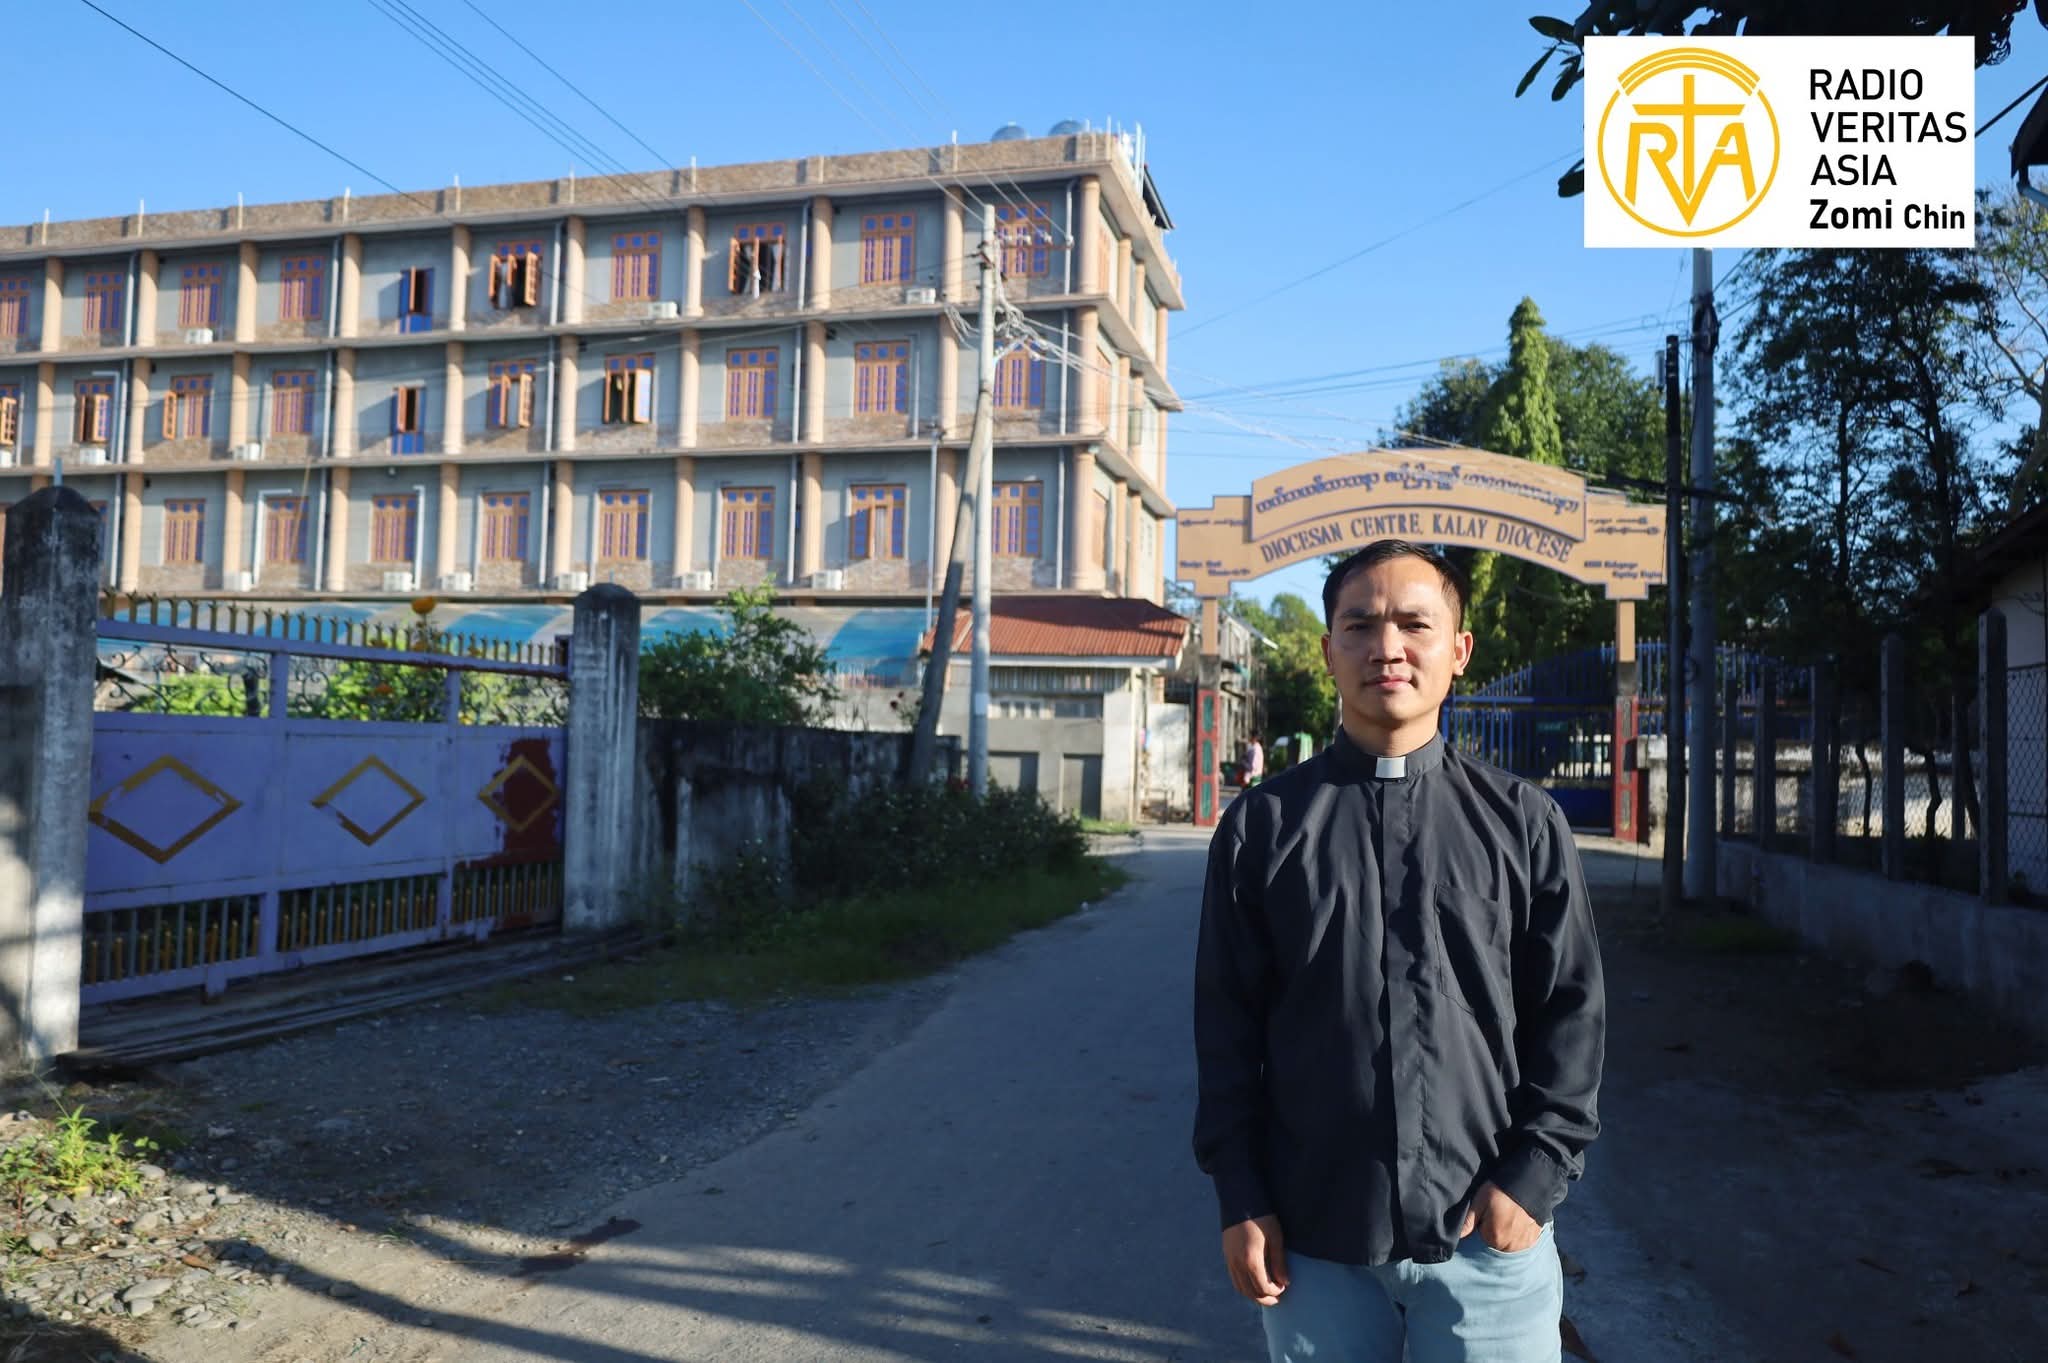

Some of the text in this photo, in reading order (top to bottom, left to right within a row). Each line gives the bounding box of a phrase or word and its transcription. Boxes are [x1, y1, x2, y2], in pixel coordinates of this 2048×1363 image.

[1260, 521, 1344, 563] DIOCESAN
[1432, 512, 1488, 540] KALAY
[1496, 521, 1574, 564] DIOCESE
